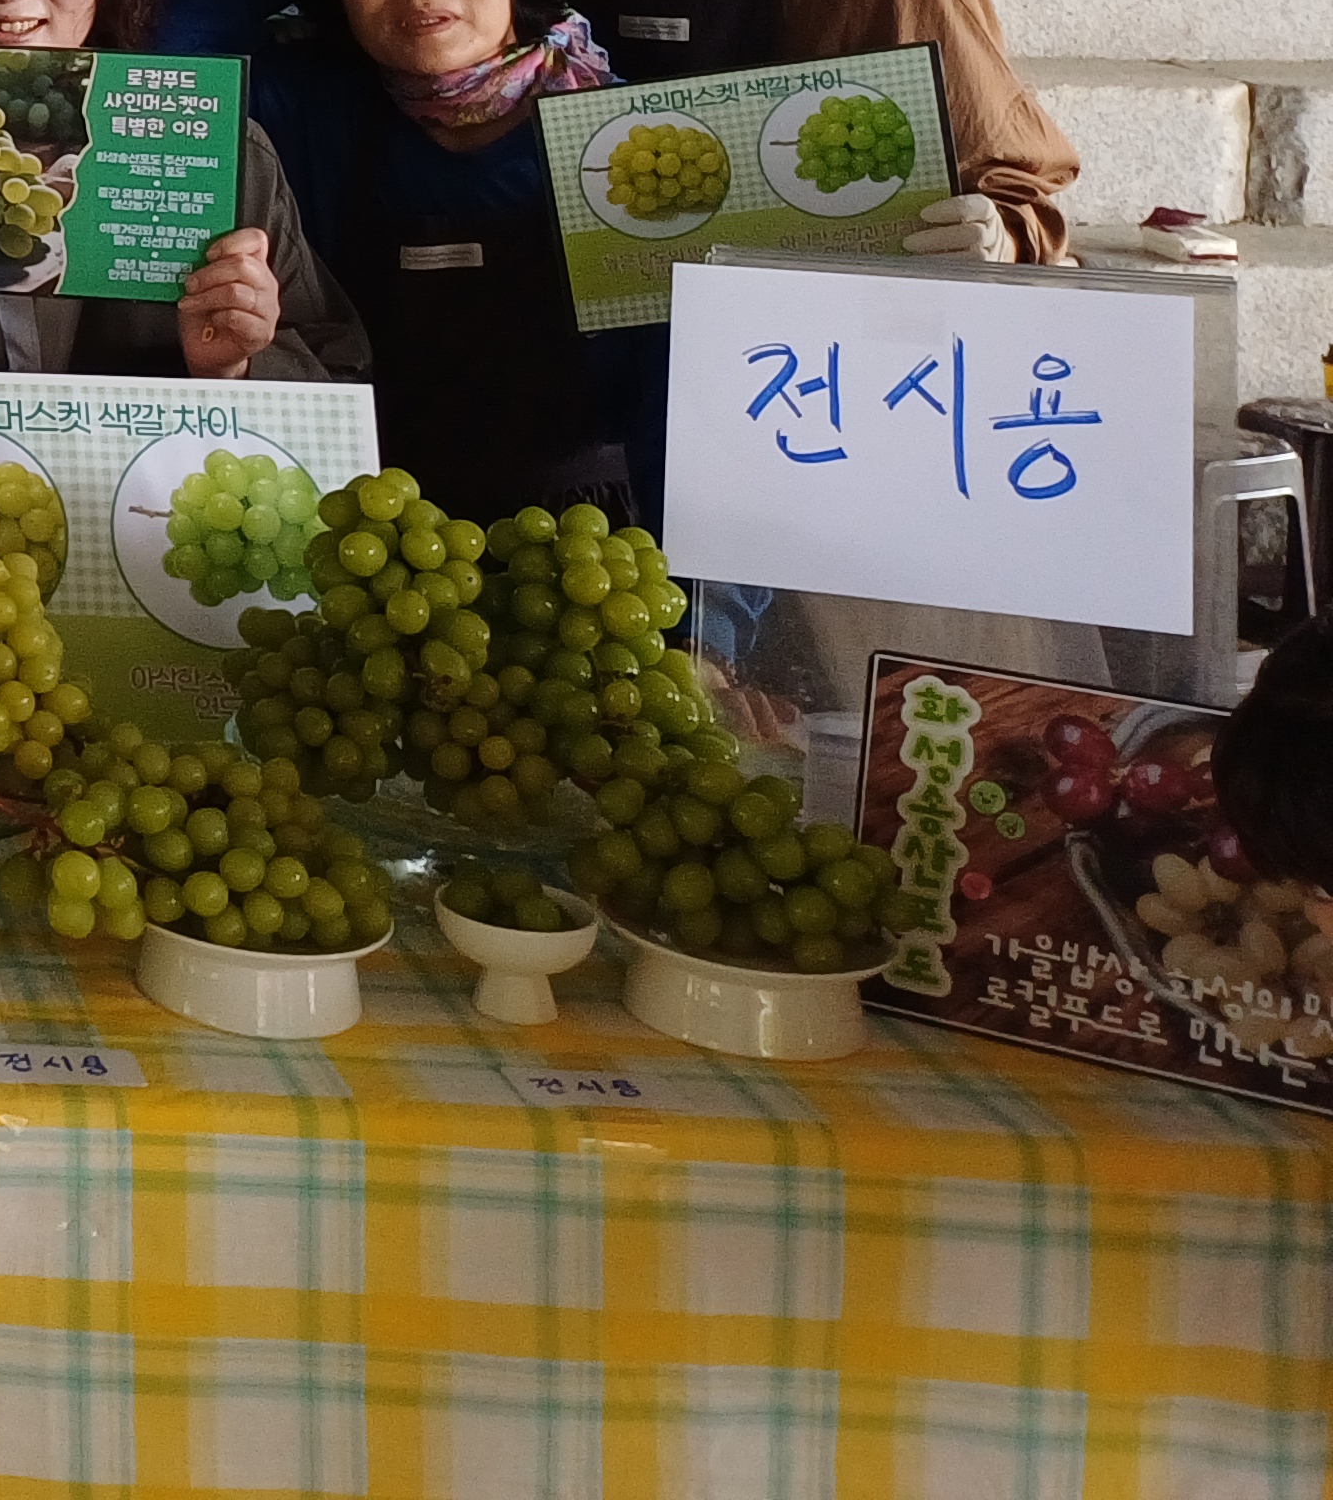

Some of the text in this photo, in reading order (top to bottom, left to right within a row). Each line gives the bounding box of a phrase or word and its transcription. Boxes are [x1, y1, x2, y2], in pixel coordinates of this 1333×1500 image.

[126, 68, 197, 90] 로컬푸드
[627, 68, 844, 115] 샤인머스켓 색깔 차이
[102, 91, 219, 117] 샤인머스켓이
[111, 116, 210, 140] 특별한 이유
[98, 402, 165, 437] 색깔
[172, 405, 241, 440] 차이
[741, 331, 1103, 501] 전시용
[977, 975, 1317, 1089] 로컬푸드로 만나는
[529, 1076, 642, 1098] 전시용
